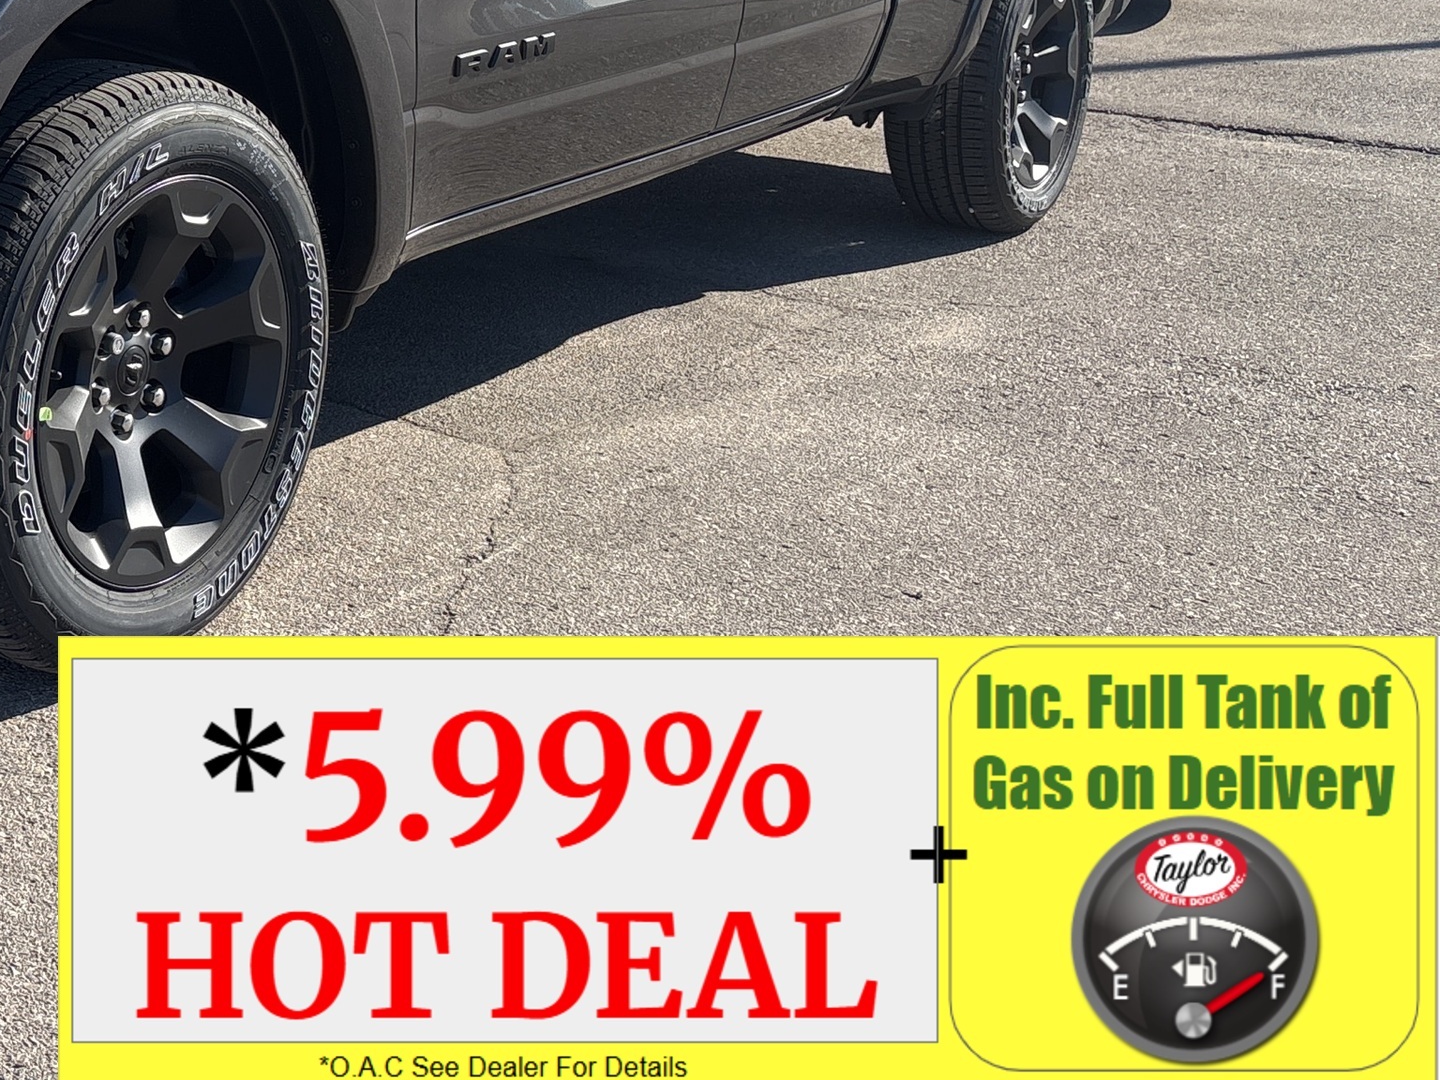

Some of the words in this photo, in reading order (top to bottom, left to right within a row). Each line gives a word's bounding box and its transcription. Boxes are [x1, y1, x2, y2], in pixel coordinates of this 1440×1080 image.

[452, 32, 556, 78] RAM
[13, 232, 80, 534] DUELER
[99, 142, 170, 217] H/L
[192, 240, 324, 620] BRIDGESTONE
